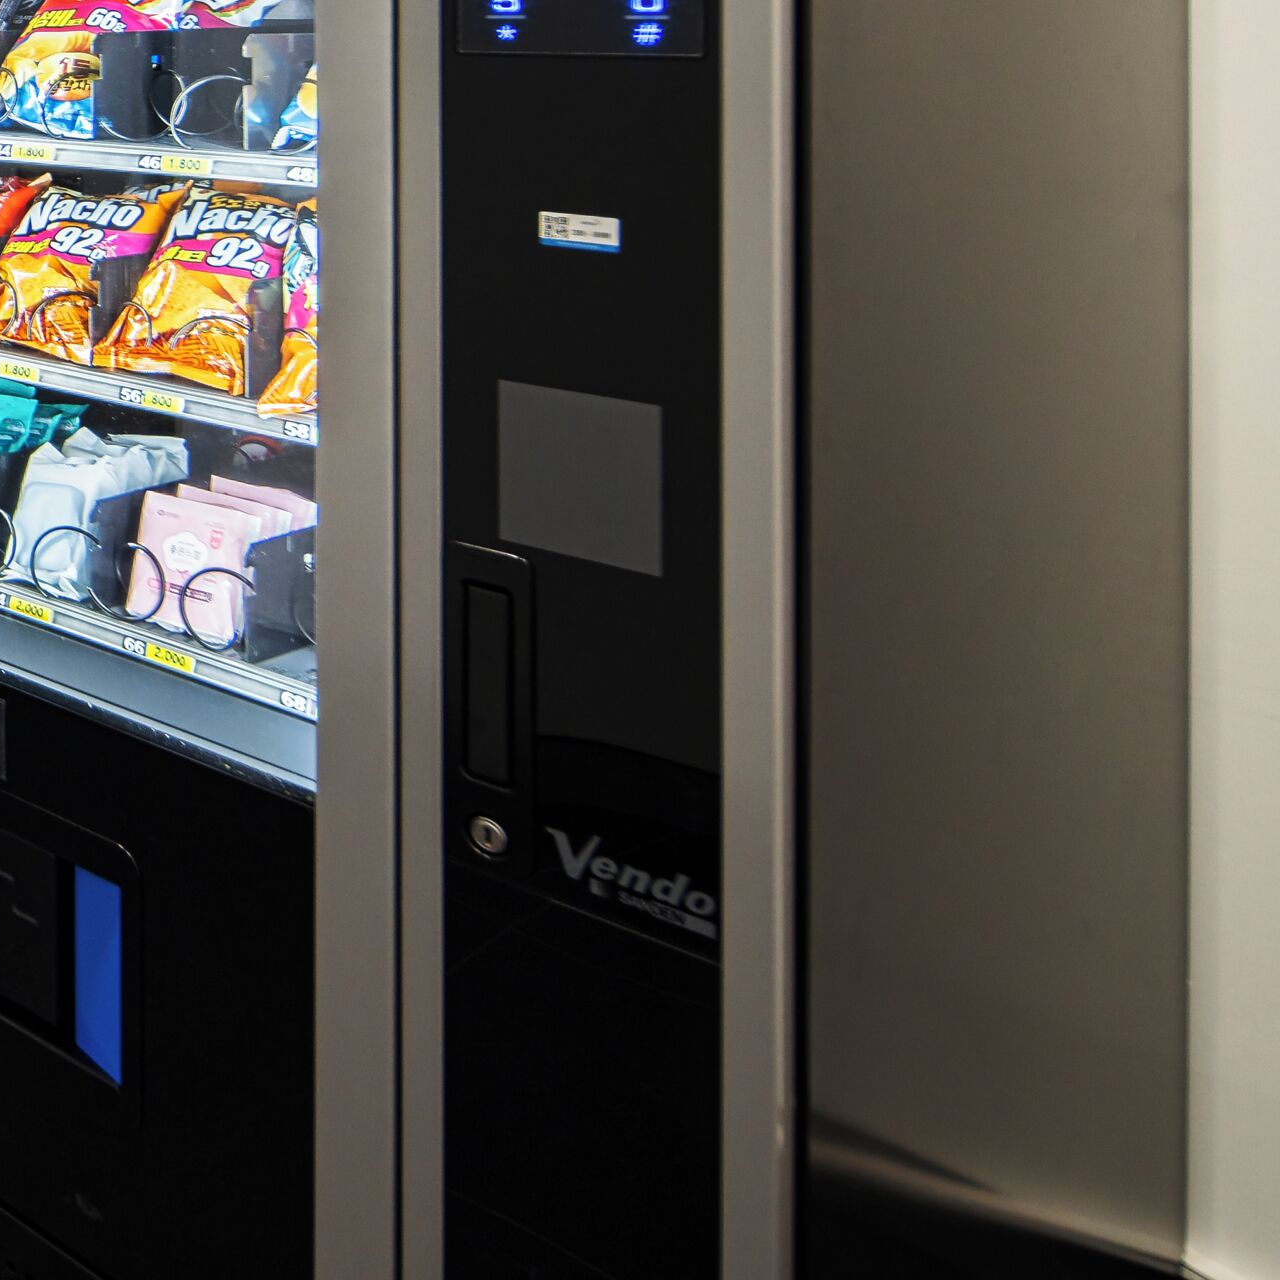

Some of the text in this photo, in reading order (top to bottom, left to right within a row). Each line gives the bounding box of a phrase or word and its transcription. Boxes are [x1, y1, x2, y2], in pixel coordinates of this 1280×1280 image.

[139, 156, 161, 169] 46
[287, 166, 313, 182] 48
[12, 194, 143, 237] Nacho
[160, 200, 293, 248] Nacho
[206, 237, 271, 278] 92g
[120, 388, 142, 402] 56
[284, 422, 310, 439] 58
[123, 638, 145, 653] 66
[281, 691, 308, 711] 68
[544, 825, 717, 917] Vendo
